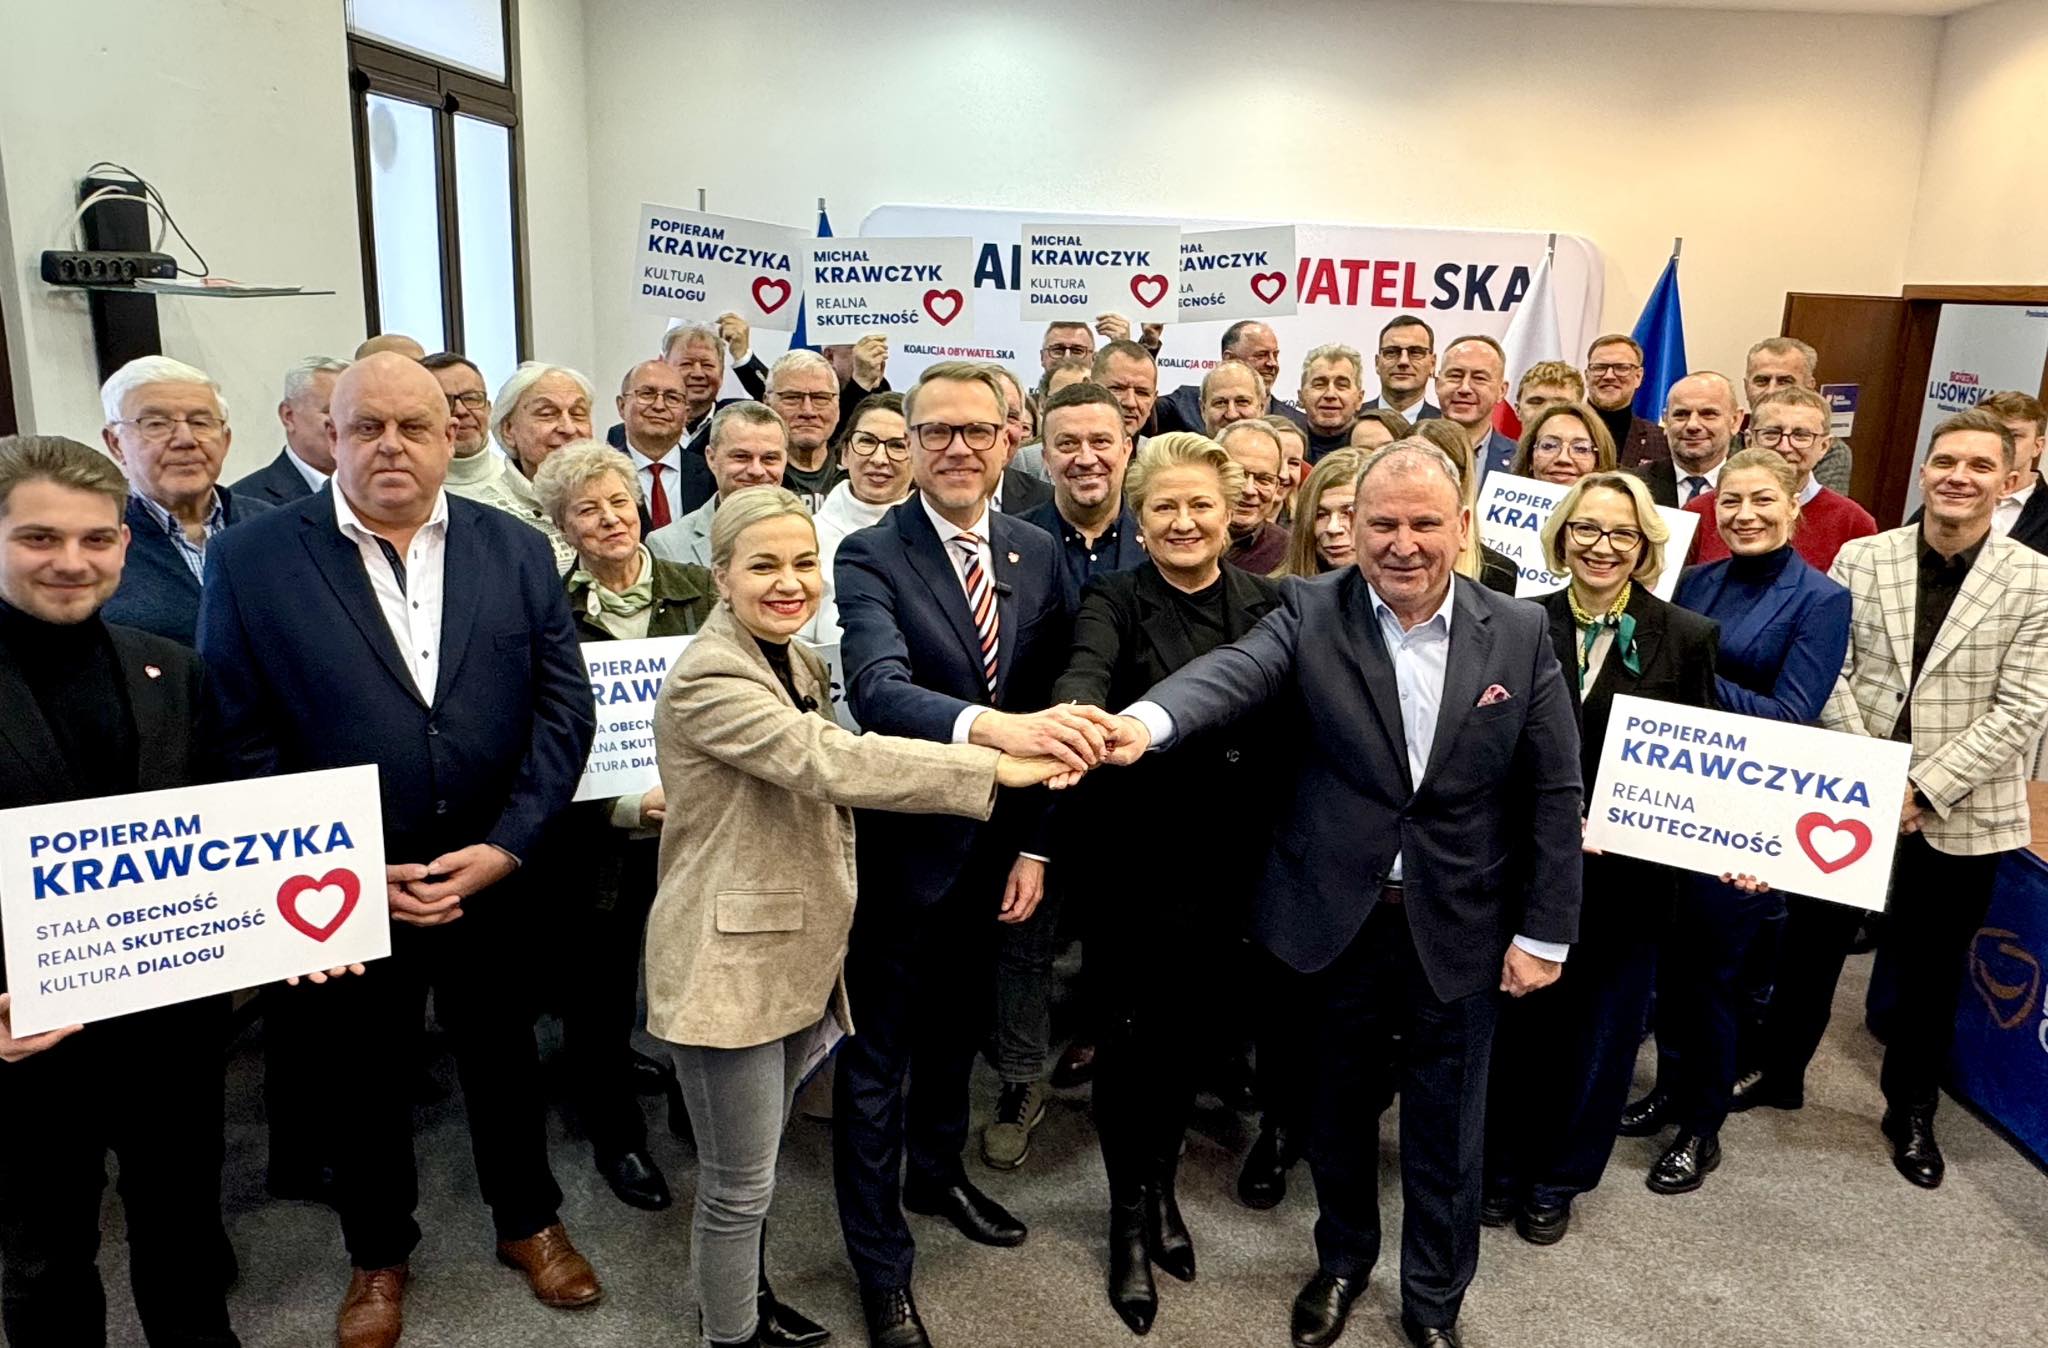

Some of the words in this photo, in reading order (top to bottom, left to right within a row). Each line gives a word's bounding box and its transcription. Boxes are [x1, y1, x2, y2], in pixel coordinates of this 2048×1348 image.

[651, 218, 725, 241] POPIERAM
[1031, 235, 1083, 247] MICHAŁ
[1180, 243, 1204, 255] HAŁ
[648, 235, 791, 272] KRAWCZYKA
[814, 249, 870, 263] MICHAŁ
[1031, 249, 1150, 267] KRAWCZYK
[644, 266, 705, 286] KULTURA
[815, 264, 943, 283] KRAWCZYK
[1031, 278, 1086, 290] KULTURA
[642, 283, 706, 302] DIALOGU
[816, 296, 867, 309] REALNA
[1030, 293, 1088, 305] DIALOGU
[816, 309, 920, 327] SKUTECZNOŚĆ
[947, 347, 1015, 360] OBYWATELSKA
[1157, 358, 1199, 370] KOALICJA
[1929, 381, 1994, 405] LISOWSK
[1486, 504, 1549, 532] KRA
[589, 657, 667, 677] PIERAM
[591, 678, 662, 706] RAW
[1626, 716, 1747, 752] POPIERAM
[1620, 738, 1871, 808] KRAWCZYKA
[1612, 782, 1695, 813] REALNA
[30, 814, 201, 858] POPIERAM
[1607, 806, 1783, 857] SKUTECZNOŚĆ
[32, 821, 354, 900] KRAWCZYKA
[36, 917, 100, 941] STAŁA
[106, 891, 218, 928] OBECNOŚĆ
[37, 941, 117, 968] REALNA
[122, 908, 266, 951] SKUTECZNOŚĆ
[40, 964, 131, 995] KULTURA
[138, 945, 225, 975] DIALOGU
